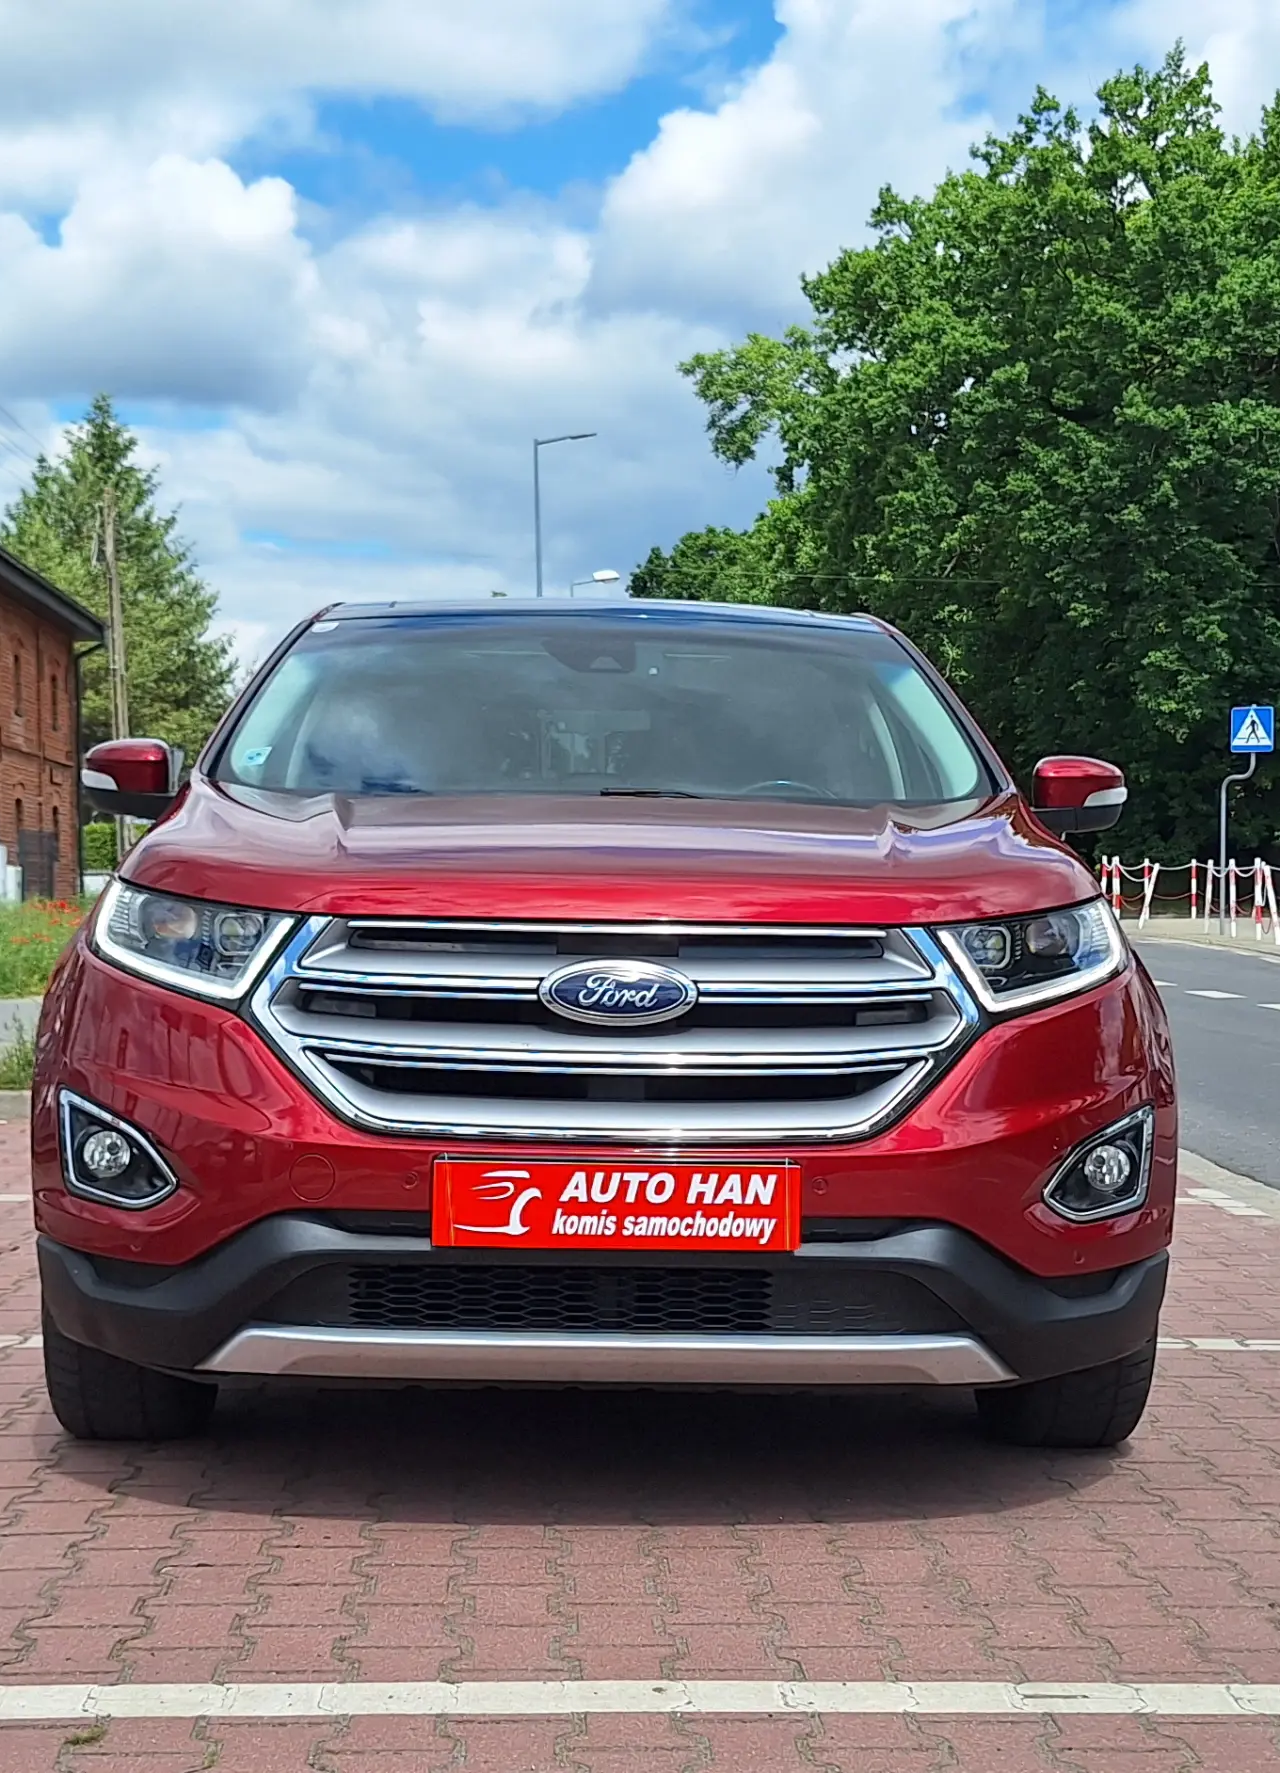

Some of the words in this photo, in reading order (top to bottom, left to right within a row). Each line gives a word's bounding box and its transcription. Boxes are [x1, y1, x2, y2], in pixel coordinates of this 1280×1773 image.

[578, 973, 660, 1008] Ford
[559, 1171, 676, 1203] AUTO
[685, 1173, 777, 1206] HAN
[551, 1208, 617, 1236] komis
[622, 1210, 777, 1244] samochodowy
